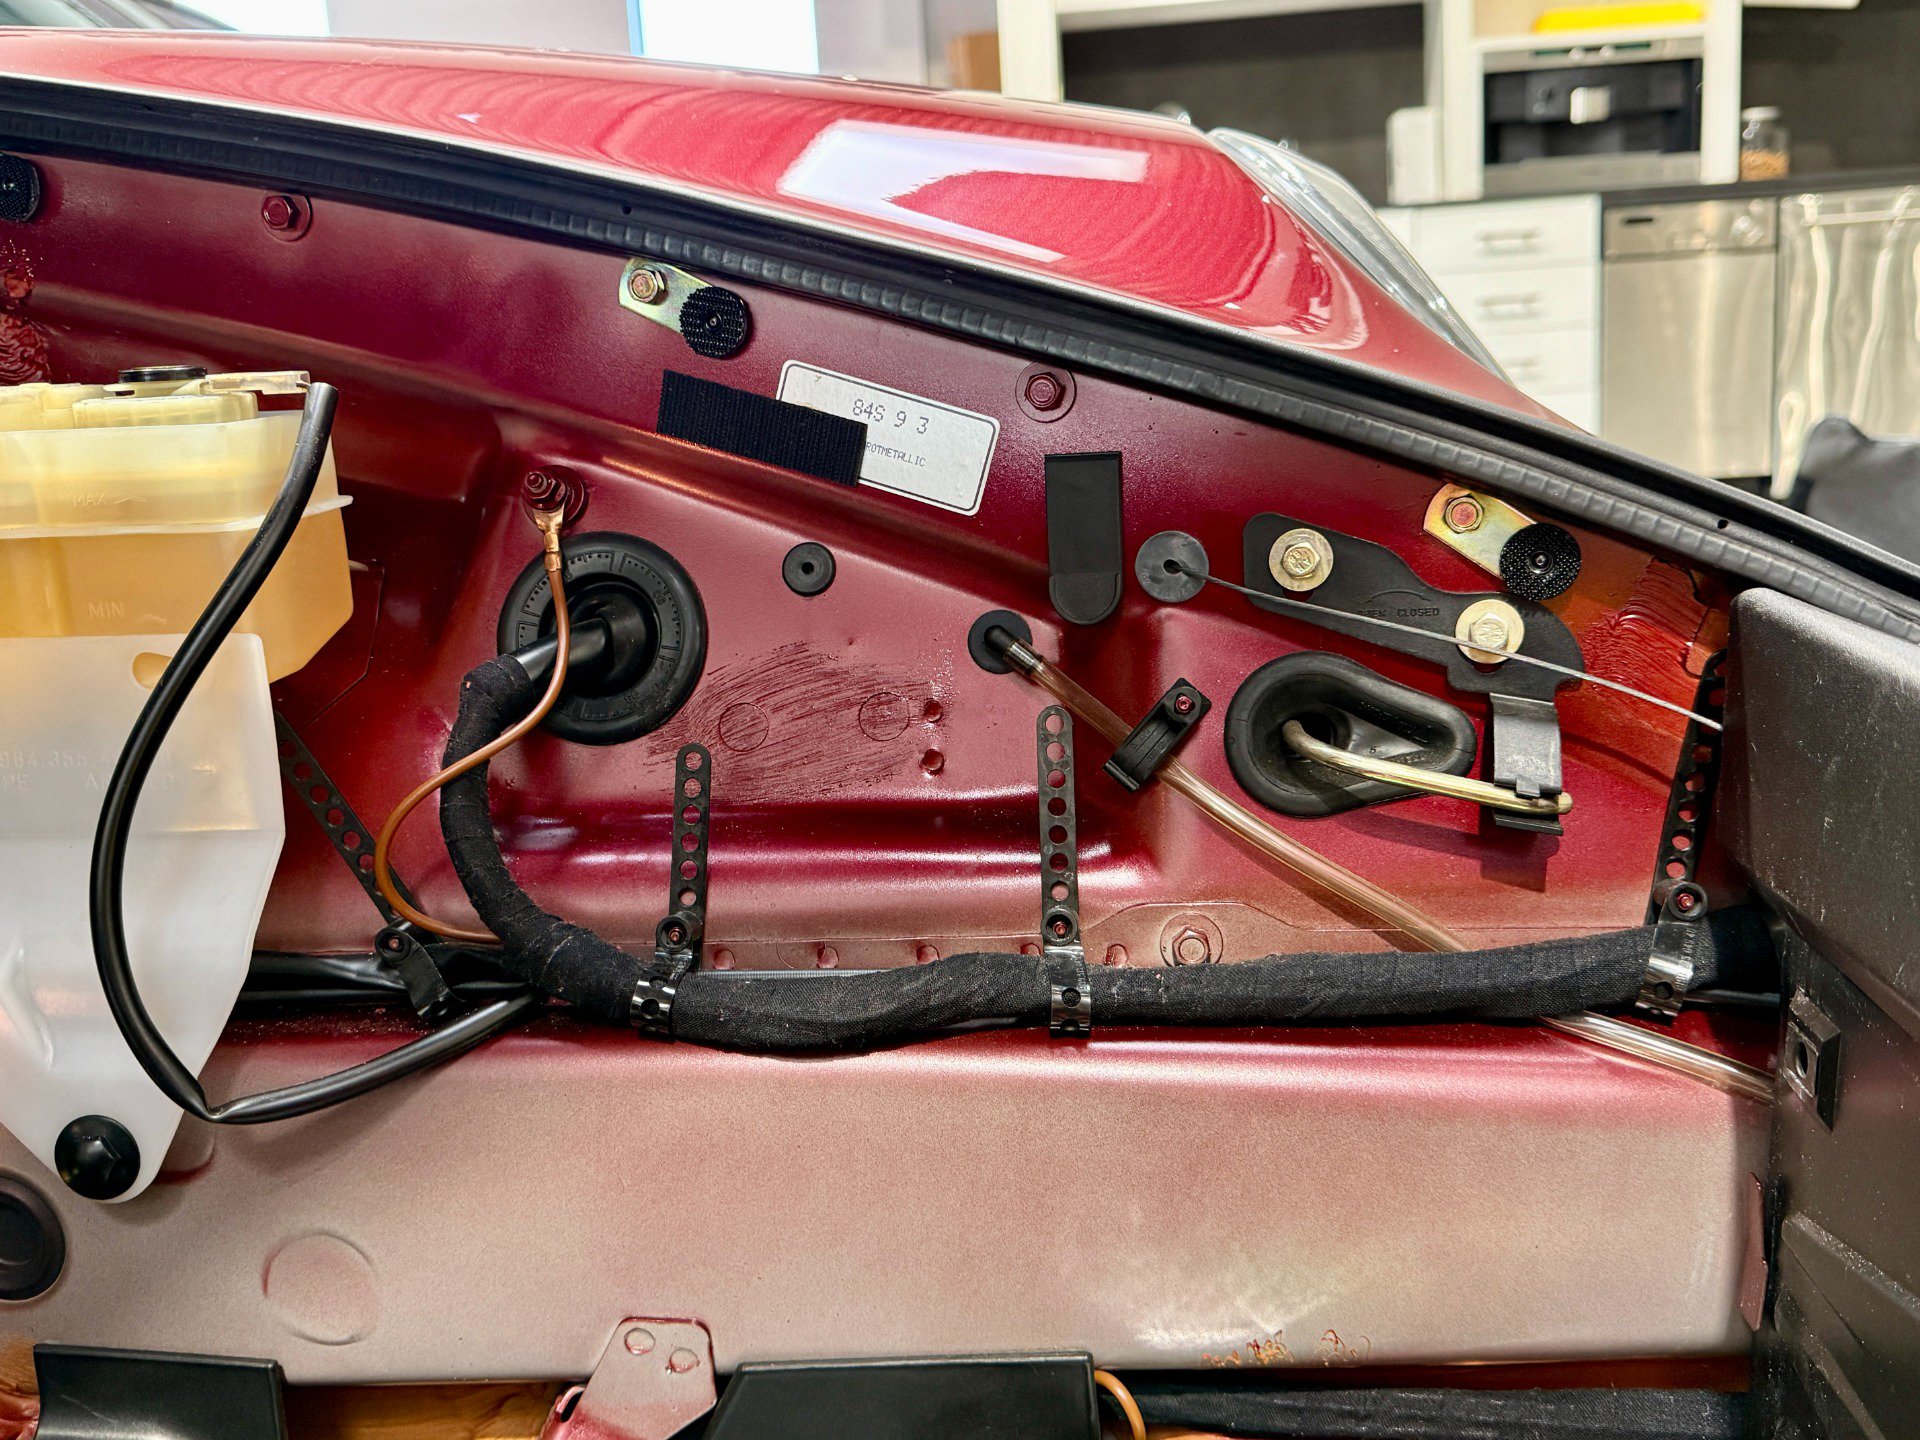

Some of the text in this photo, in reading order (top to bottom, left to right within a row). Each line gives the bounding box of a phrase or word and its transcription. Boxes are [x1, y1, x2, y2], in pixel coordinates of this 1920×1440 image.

[852, 399, 930, 435] 84S 9 3
[72, 491, 106, 507] MAX
[88, 601, 124, 619] MIN
[1396, 608, 1441, 620] CLOSED
